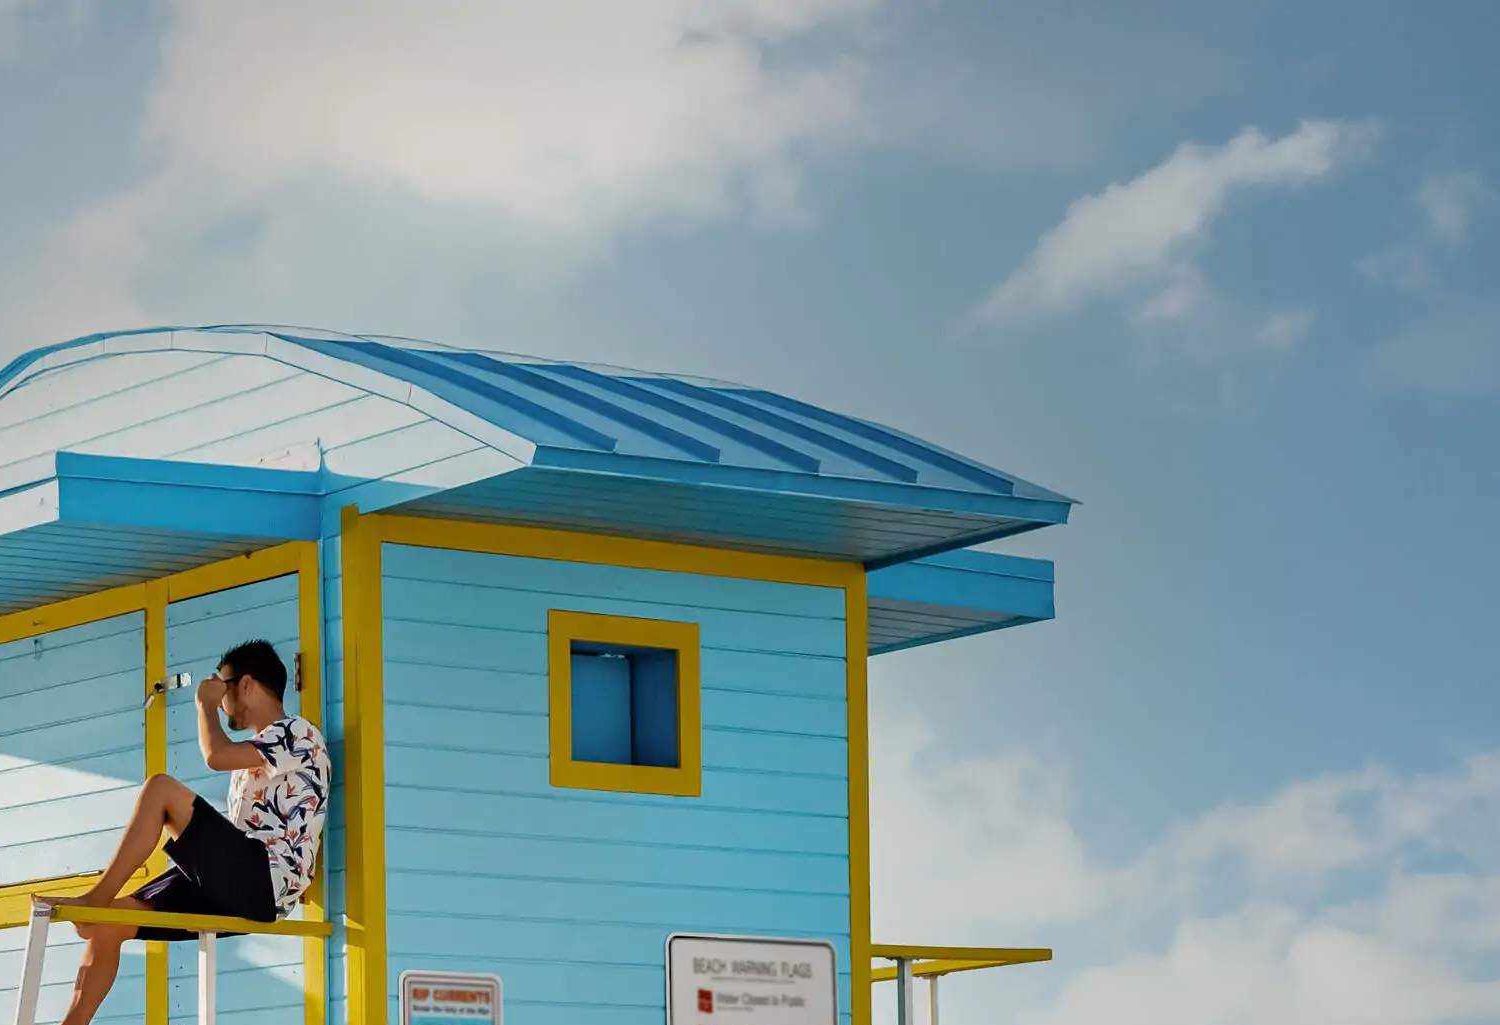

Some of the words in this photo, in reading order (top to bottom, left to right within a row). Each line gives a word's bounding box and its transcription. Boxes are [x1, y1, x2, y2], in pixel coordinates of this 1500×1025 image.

[692, 957, 728, 974] BEACH
[731, 960, 777, 976] WARNING
[781, 961, 812, 979] FLAGS
